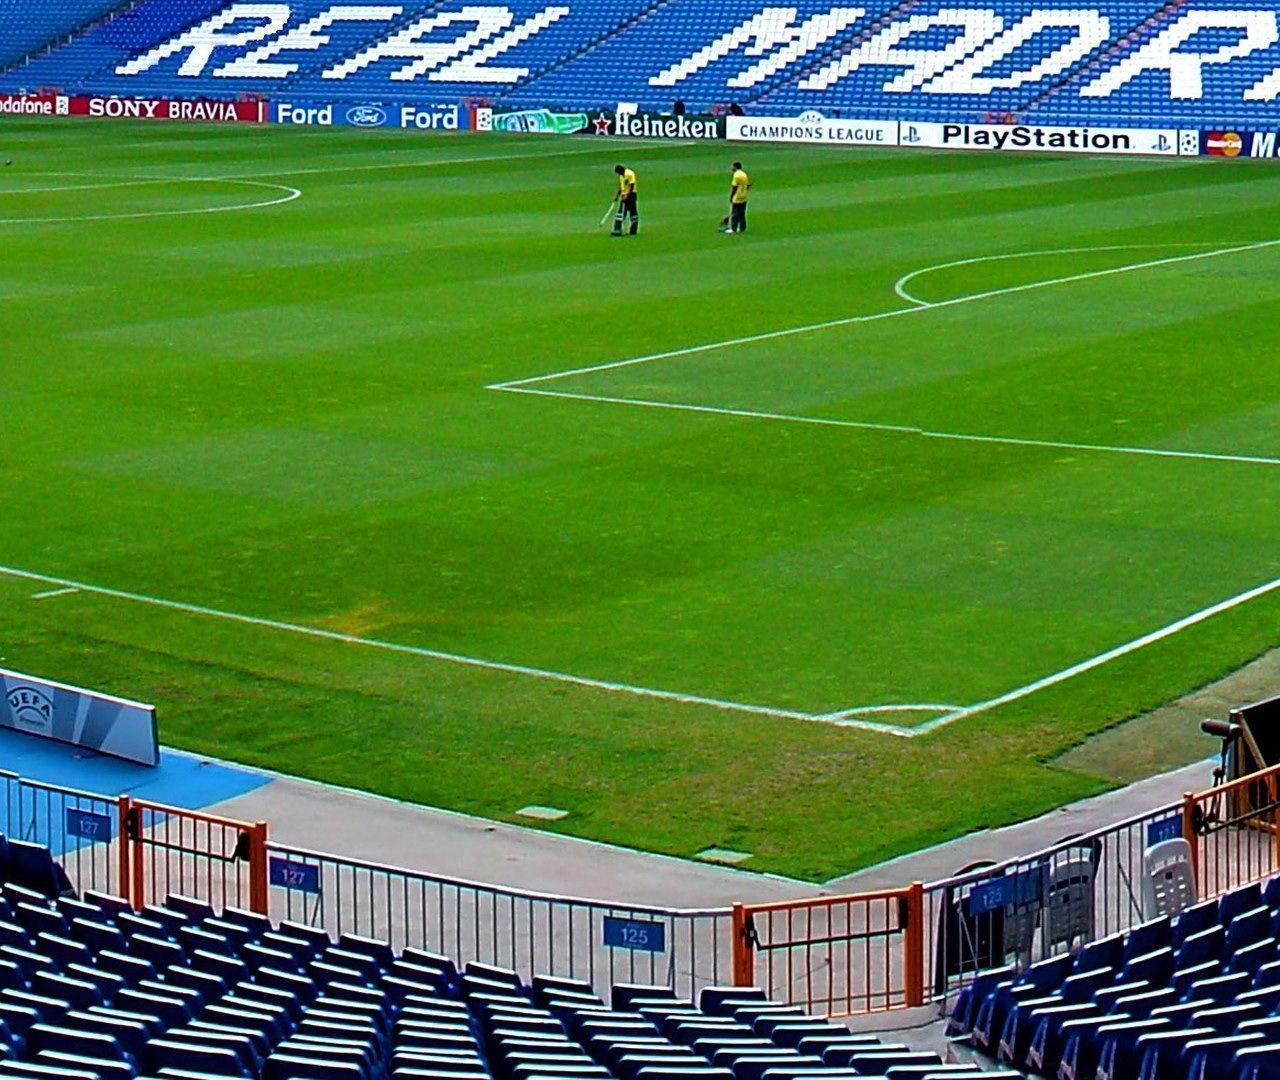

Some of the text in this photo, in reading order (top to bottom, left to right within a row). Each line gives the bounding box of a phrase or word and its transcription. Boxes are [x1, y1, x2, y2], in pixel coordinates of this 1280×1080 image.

[115, 3, 570, 83] REAL
[89, 99, 238, 121] SONY BRAVIA
[277, 103, 332, 125] Ford
[401, 107, 458, 129] Ford
[614, 113, 718, 138] Heineken
[739, 124, 883, 142] CHAMPIONS LEAGUE
[943, 125, 1130, 150] PlayStation
[10, 691, 51, 717] UEFA
[80, 819, 99, 834] 127
[282, 868, 305, 882] 127
[621, 928, 648, 944] 125
